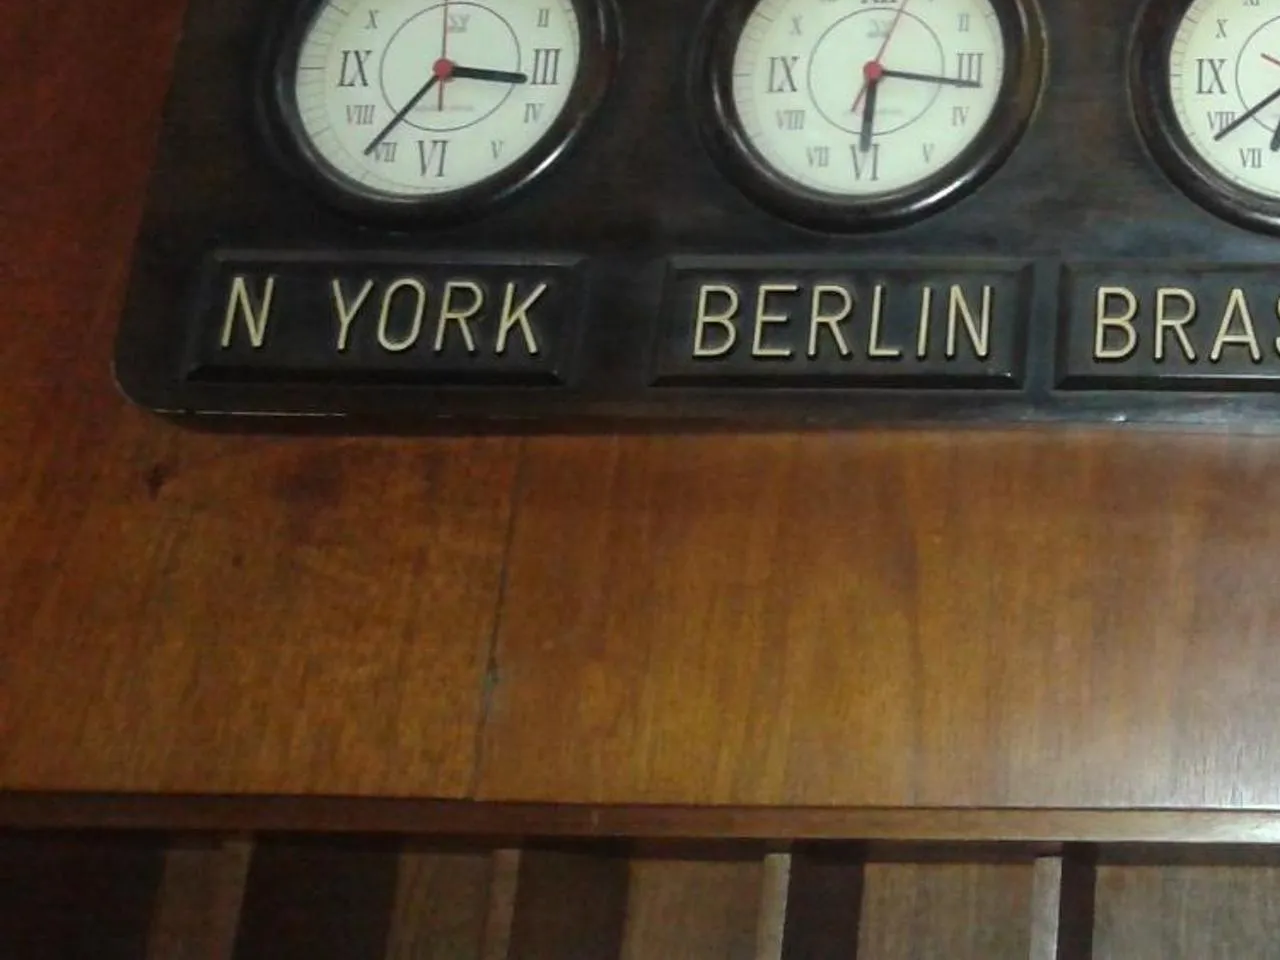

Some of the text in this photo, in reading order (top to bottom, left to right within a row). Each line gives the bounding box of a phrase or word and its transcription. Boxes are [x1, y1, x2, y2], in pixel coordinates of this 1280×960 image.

[364, 9, 380, 29] X
[537, 8, 550, 28] II
[789, 15, 803, 36] X
[957, 13, 970, 32] II
[1215, 18, 1229, 39] X
[338, 50, 373, 87] IX
[530, 48, 562, 85] III
[766, 56, 800, 94] IX
[956, 52, 984, 88] III
[1196, 58, 1227, 95] IX
[346, 104, 376, 125] VIII
[523, 103, 544, 123] IV
[775, 110, 806, 130] VIII
[952, 106, 970, 126] IV
[418, 140, 448, 177] VI
[491, 141, 505, 160] V
[806, 146, 830, 167] VII
[922, 143, 935, 163] V
[1239, 148, 1262, 168] VII
[850, 143, 881, 181] VI
[221, 276, 549, 355] N YORK
[692, 283, 995, 359] BERLIN
